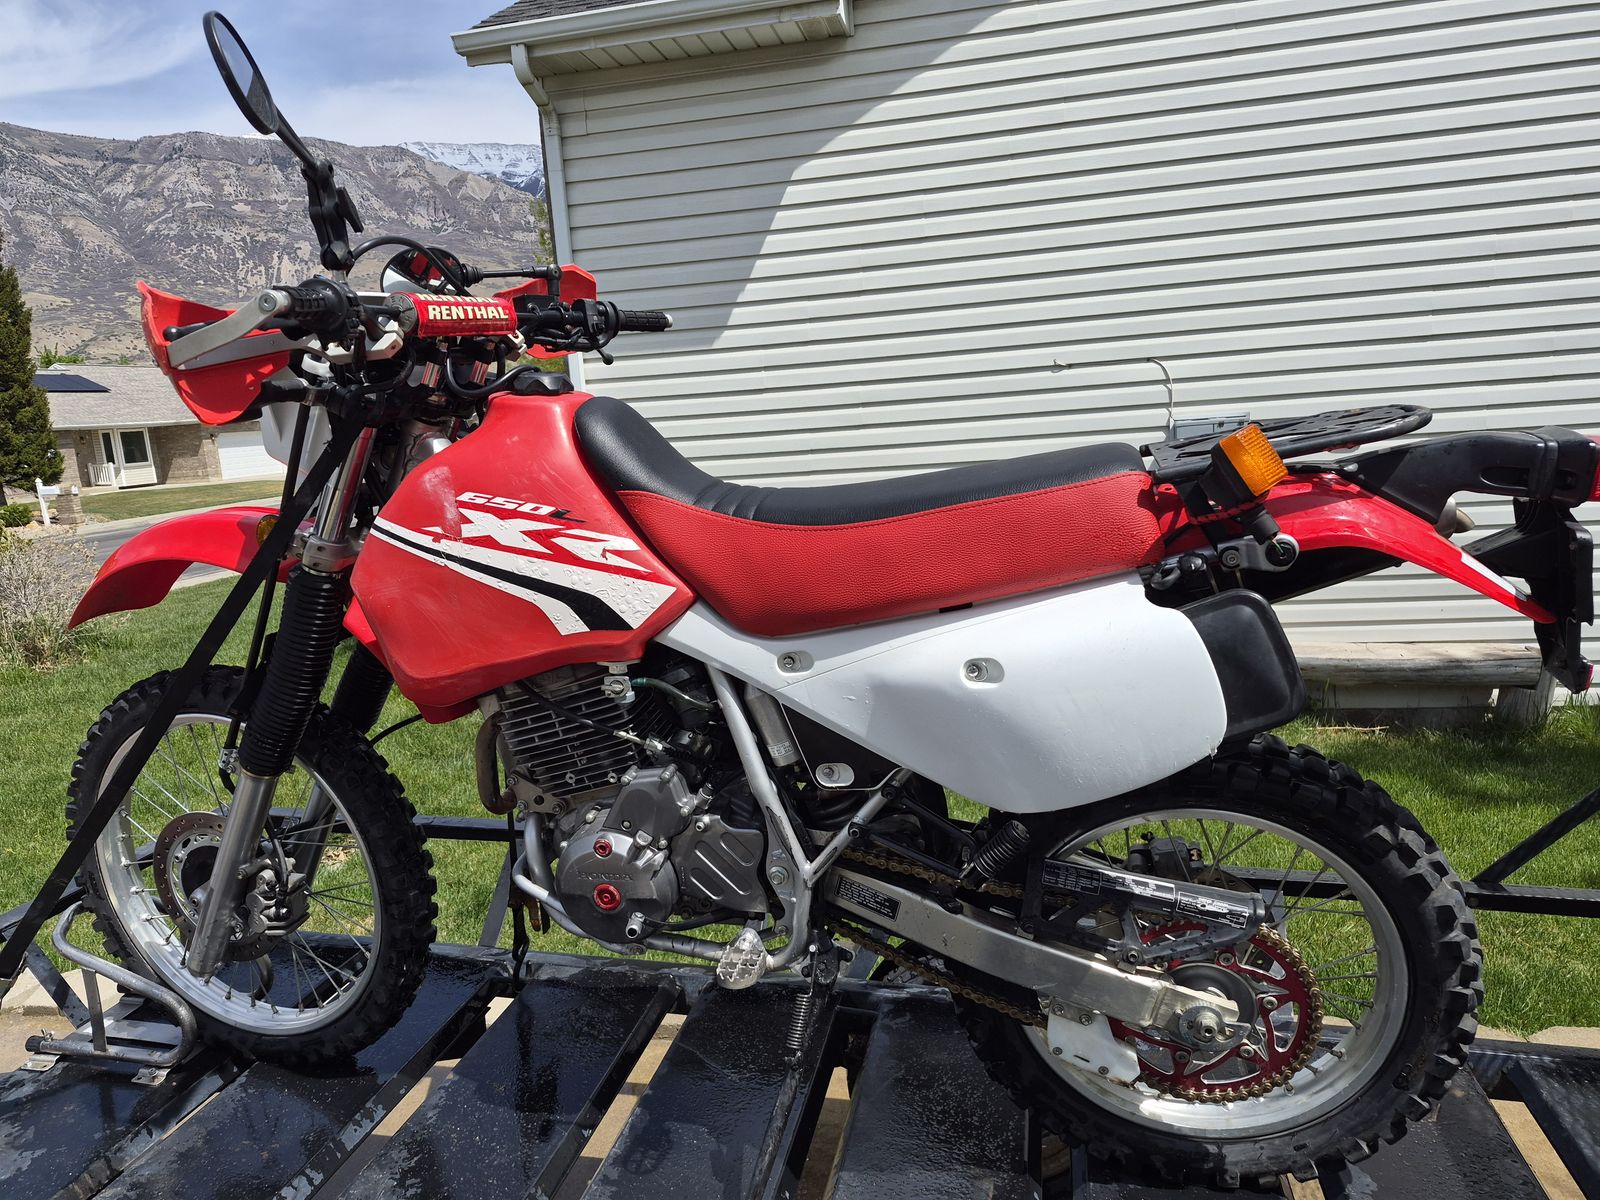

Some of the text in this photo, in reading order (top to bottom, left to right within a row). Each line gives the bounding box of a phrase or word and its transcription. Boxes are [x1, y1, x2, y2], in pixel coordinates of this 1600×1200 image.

[427, 305, 509, 320] RENTHAL
[455, 491, 587, 523] 650L
[421, 507, 654, 572] XR
